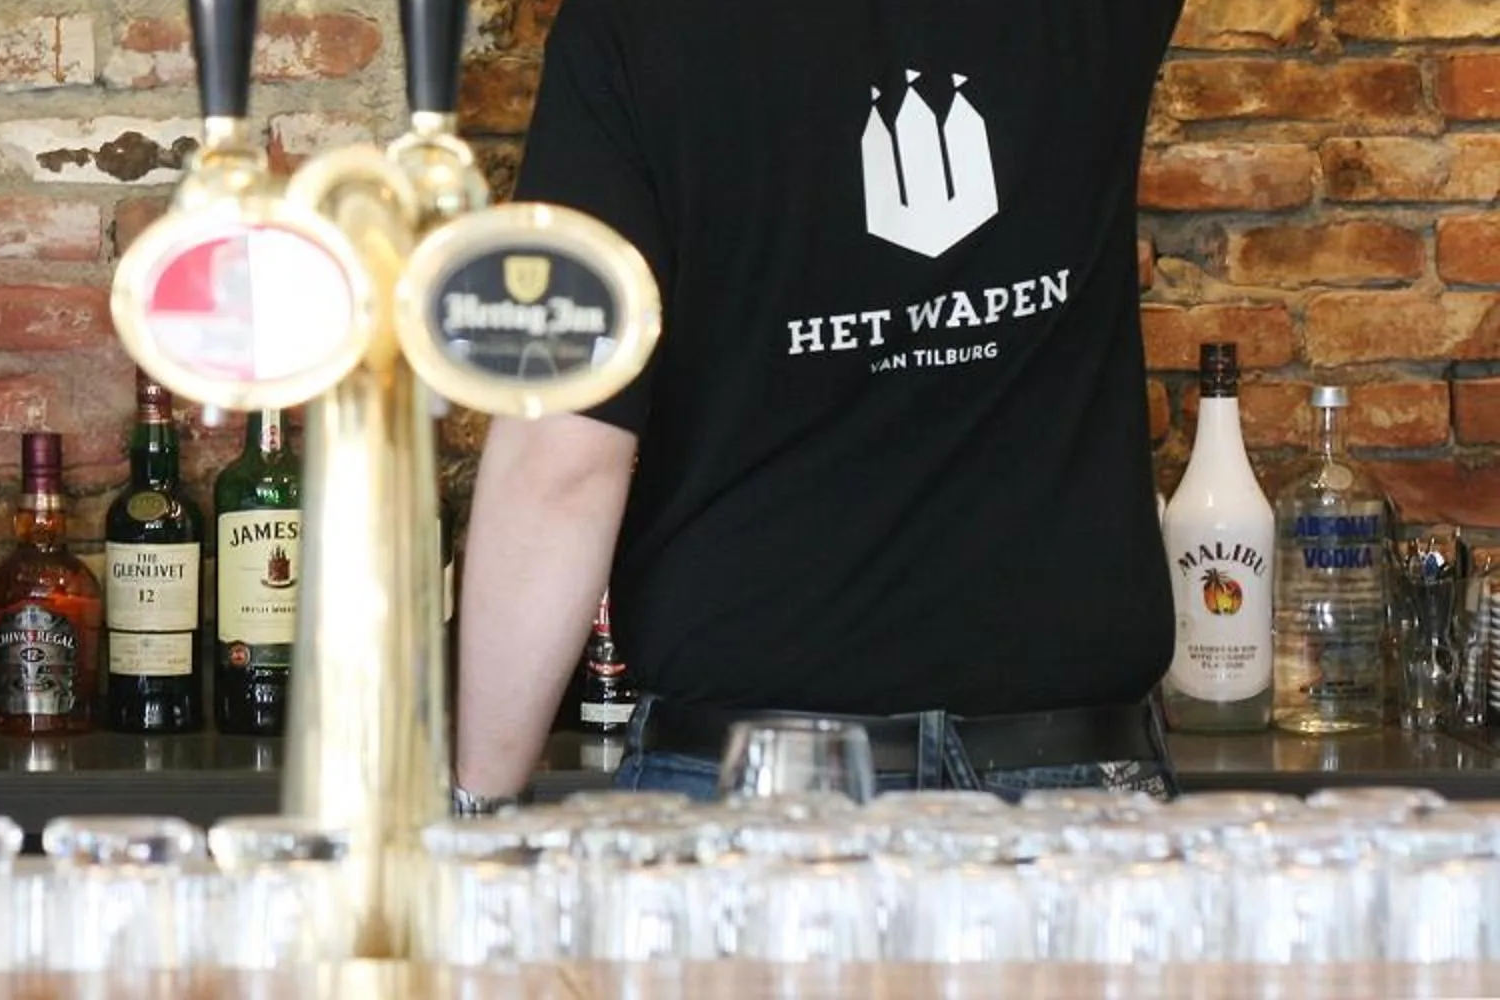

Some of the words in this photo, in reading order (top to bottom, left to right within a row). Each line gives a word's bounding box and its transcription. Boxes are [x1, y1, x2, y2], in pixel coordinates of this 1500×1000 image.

[787, 309, 891, 355] HET
[905, 269, 1070, 333] WAPEN
[870, 353, 907, 374] VAN
[913, 342, 998, 367] TILBURG
[230, 521, 299, 547] JAMES
[1178, 541, 1267, 577] MALIBU
[1303, 547, 1374, 569] VODKA
[113, 563, 184, 580] GLENLIVET
[138, 589, 155, 603] 12
[37, 631, 75, 649] REGAL
